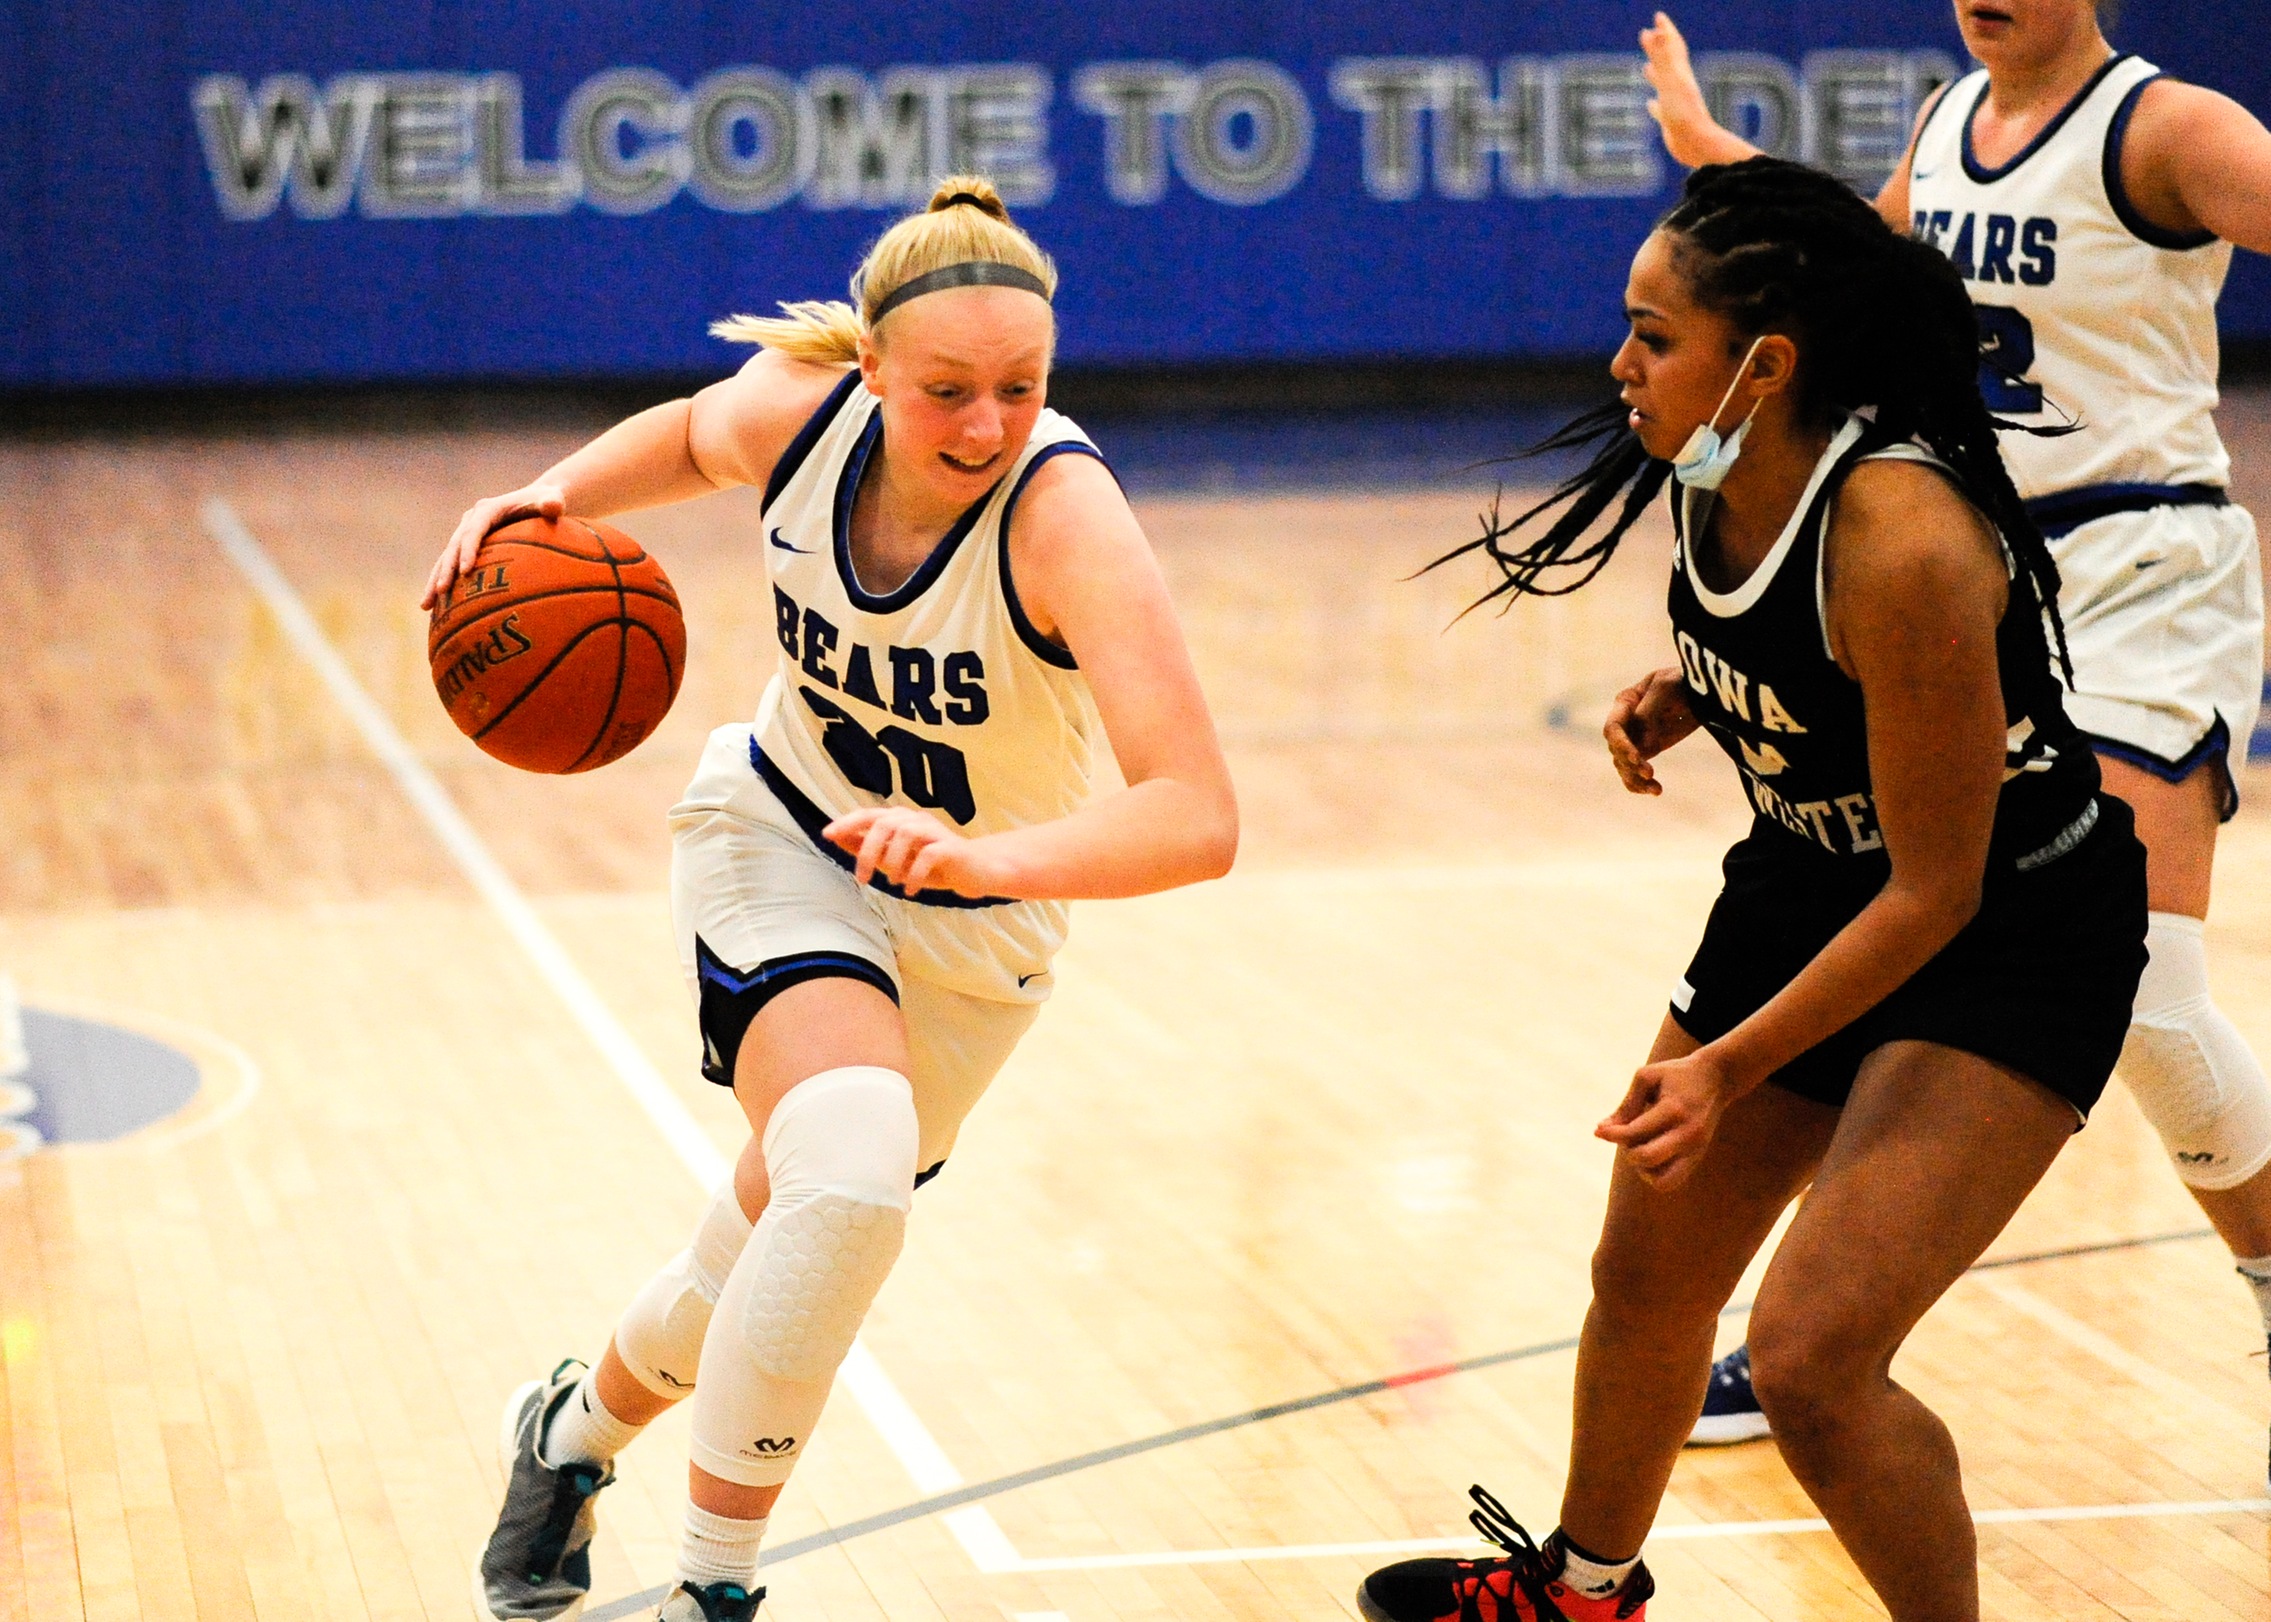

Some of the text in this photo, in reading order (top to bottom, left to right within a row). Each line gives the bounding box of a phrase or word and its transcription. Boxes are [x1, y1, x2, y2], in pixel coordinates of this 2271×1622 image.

[191, 48, 1962, 221] WELCOME TO THE DE
[772, 580, 990, 725] BEARS
[1678, 630, 1808, 733] OWA
